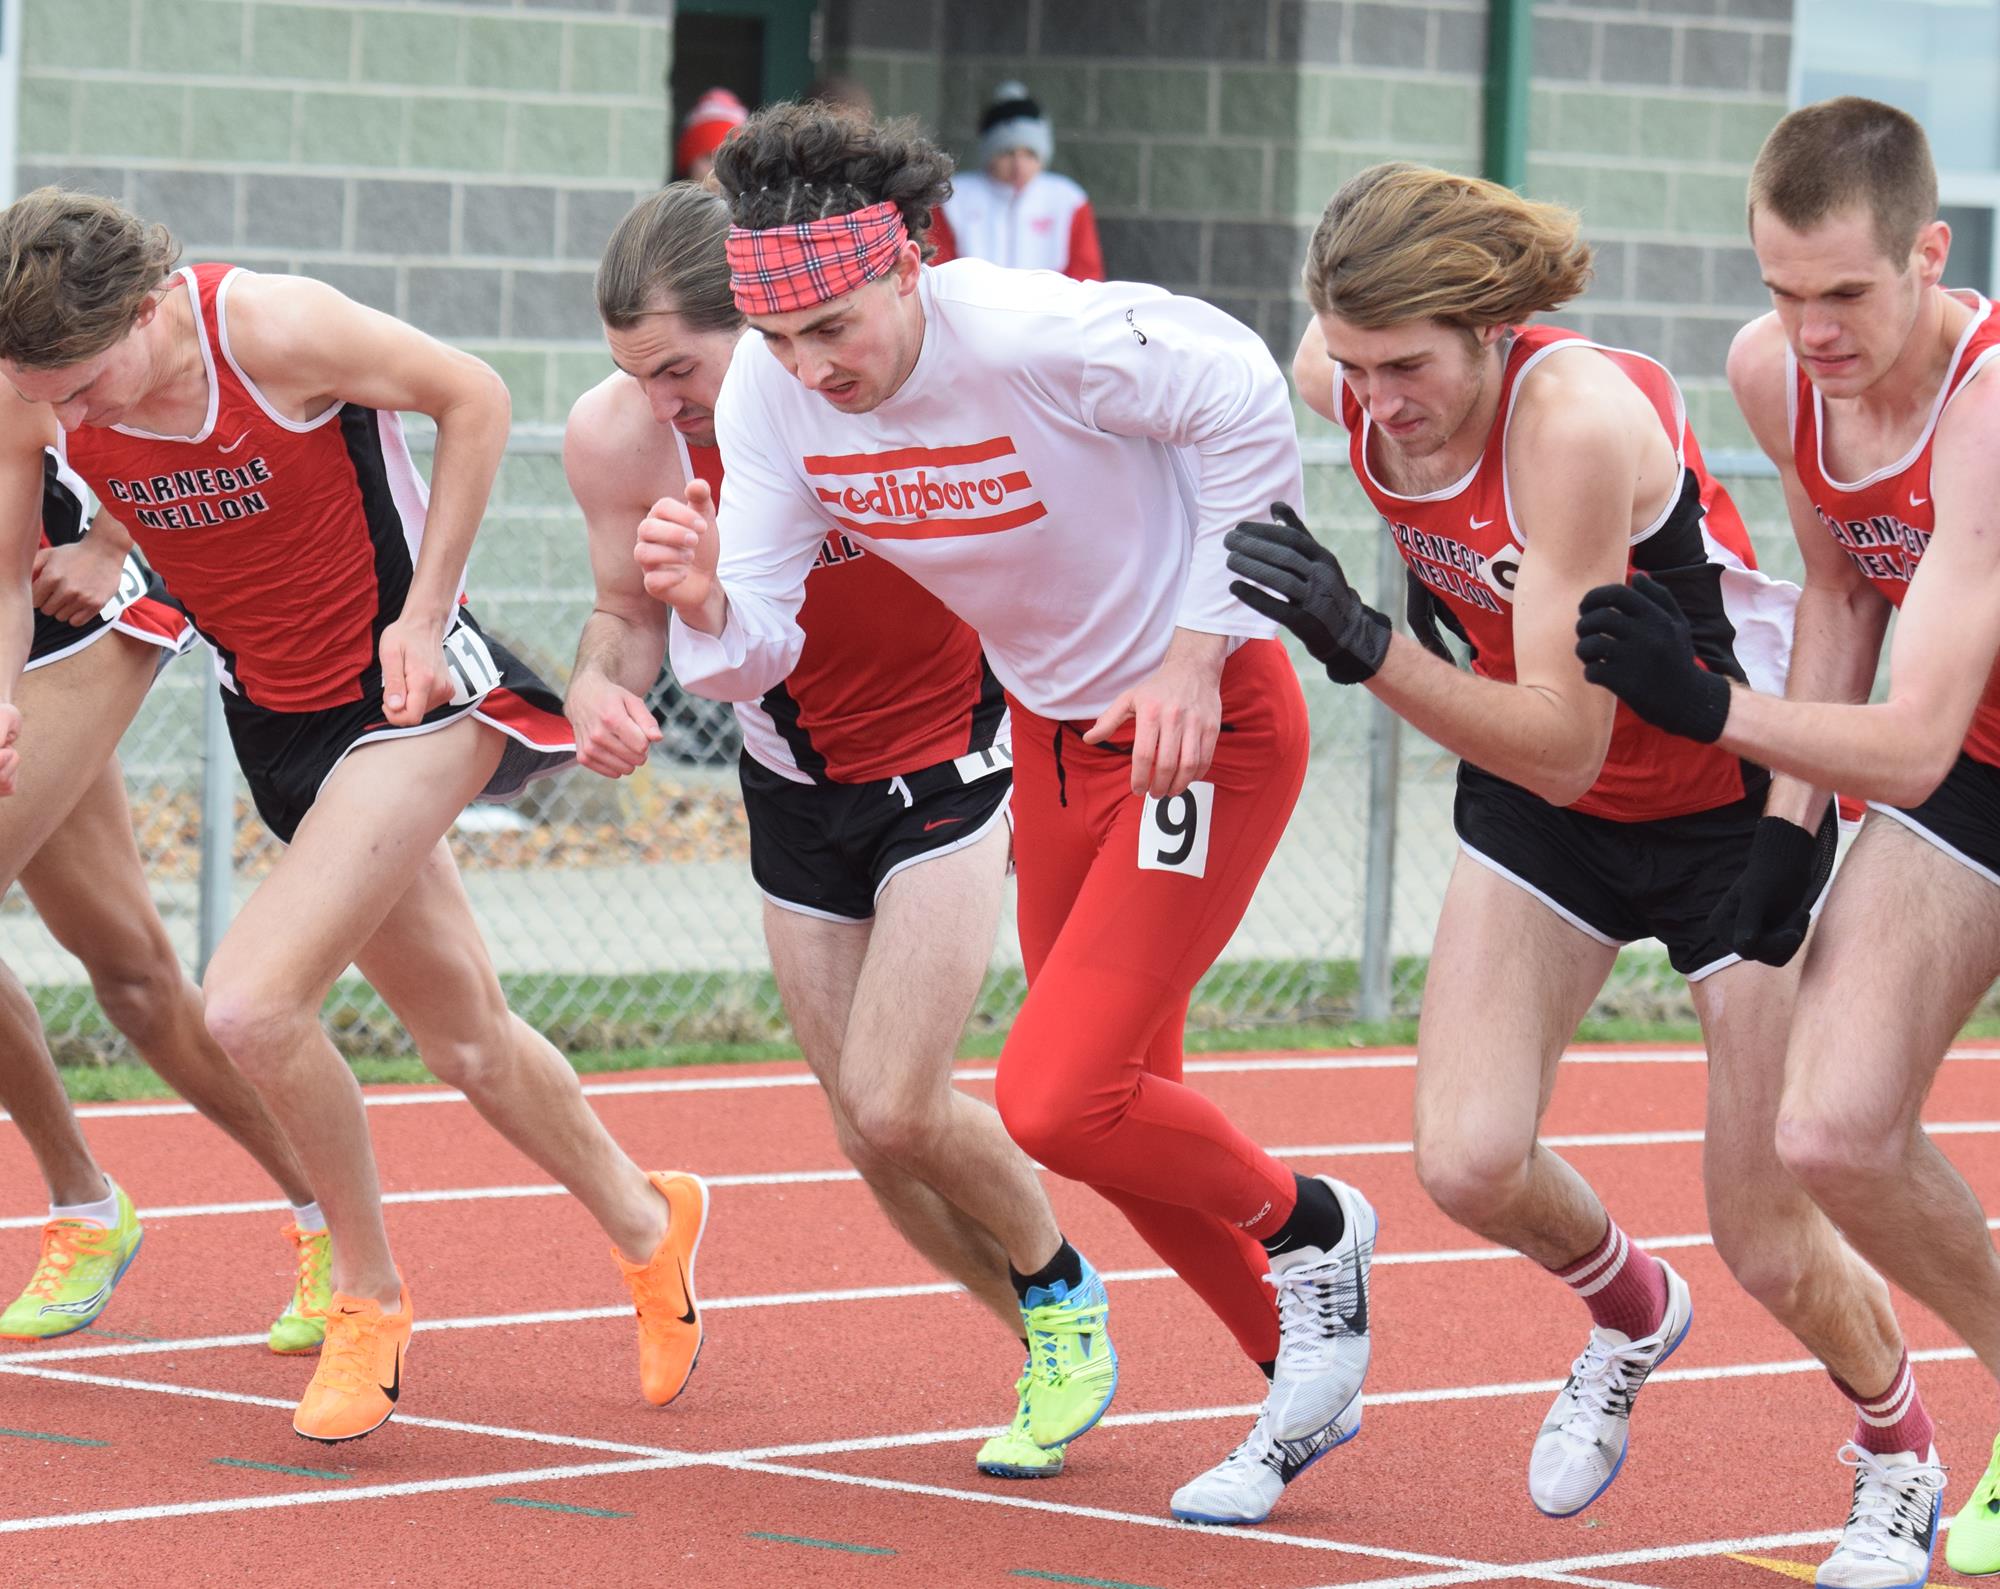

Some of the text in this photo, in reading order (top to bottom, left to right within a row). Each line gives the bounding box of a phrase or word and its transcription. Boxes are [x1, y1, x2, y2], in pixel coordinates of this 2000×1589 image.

[107, 457, 272, 505] CARNEGIE
[842, 470, 1004, 520] edinboro
[135, 491, 270, 530] MELLON
[1407, 552, 1504, 615] MELLON
[1155, 787, 1198, 866] 9
